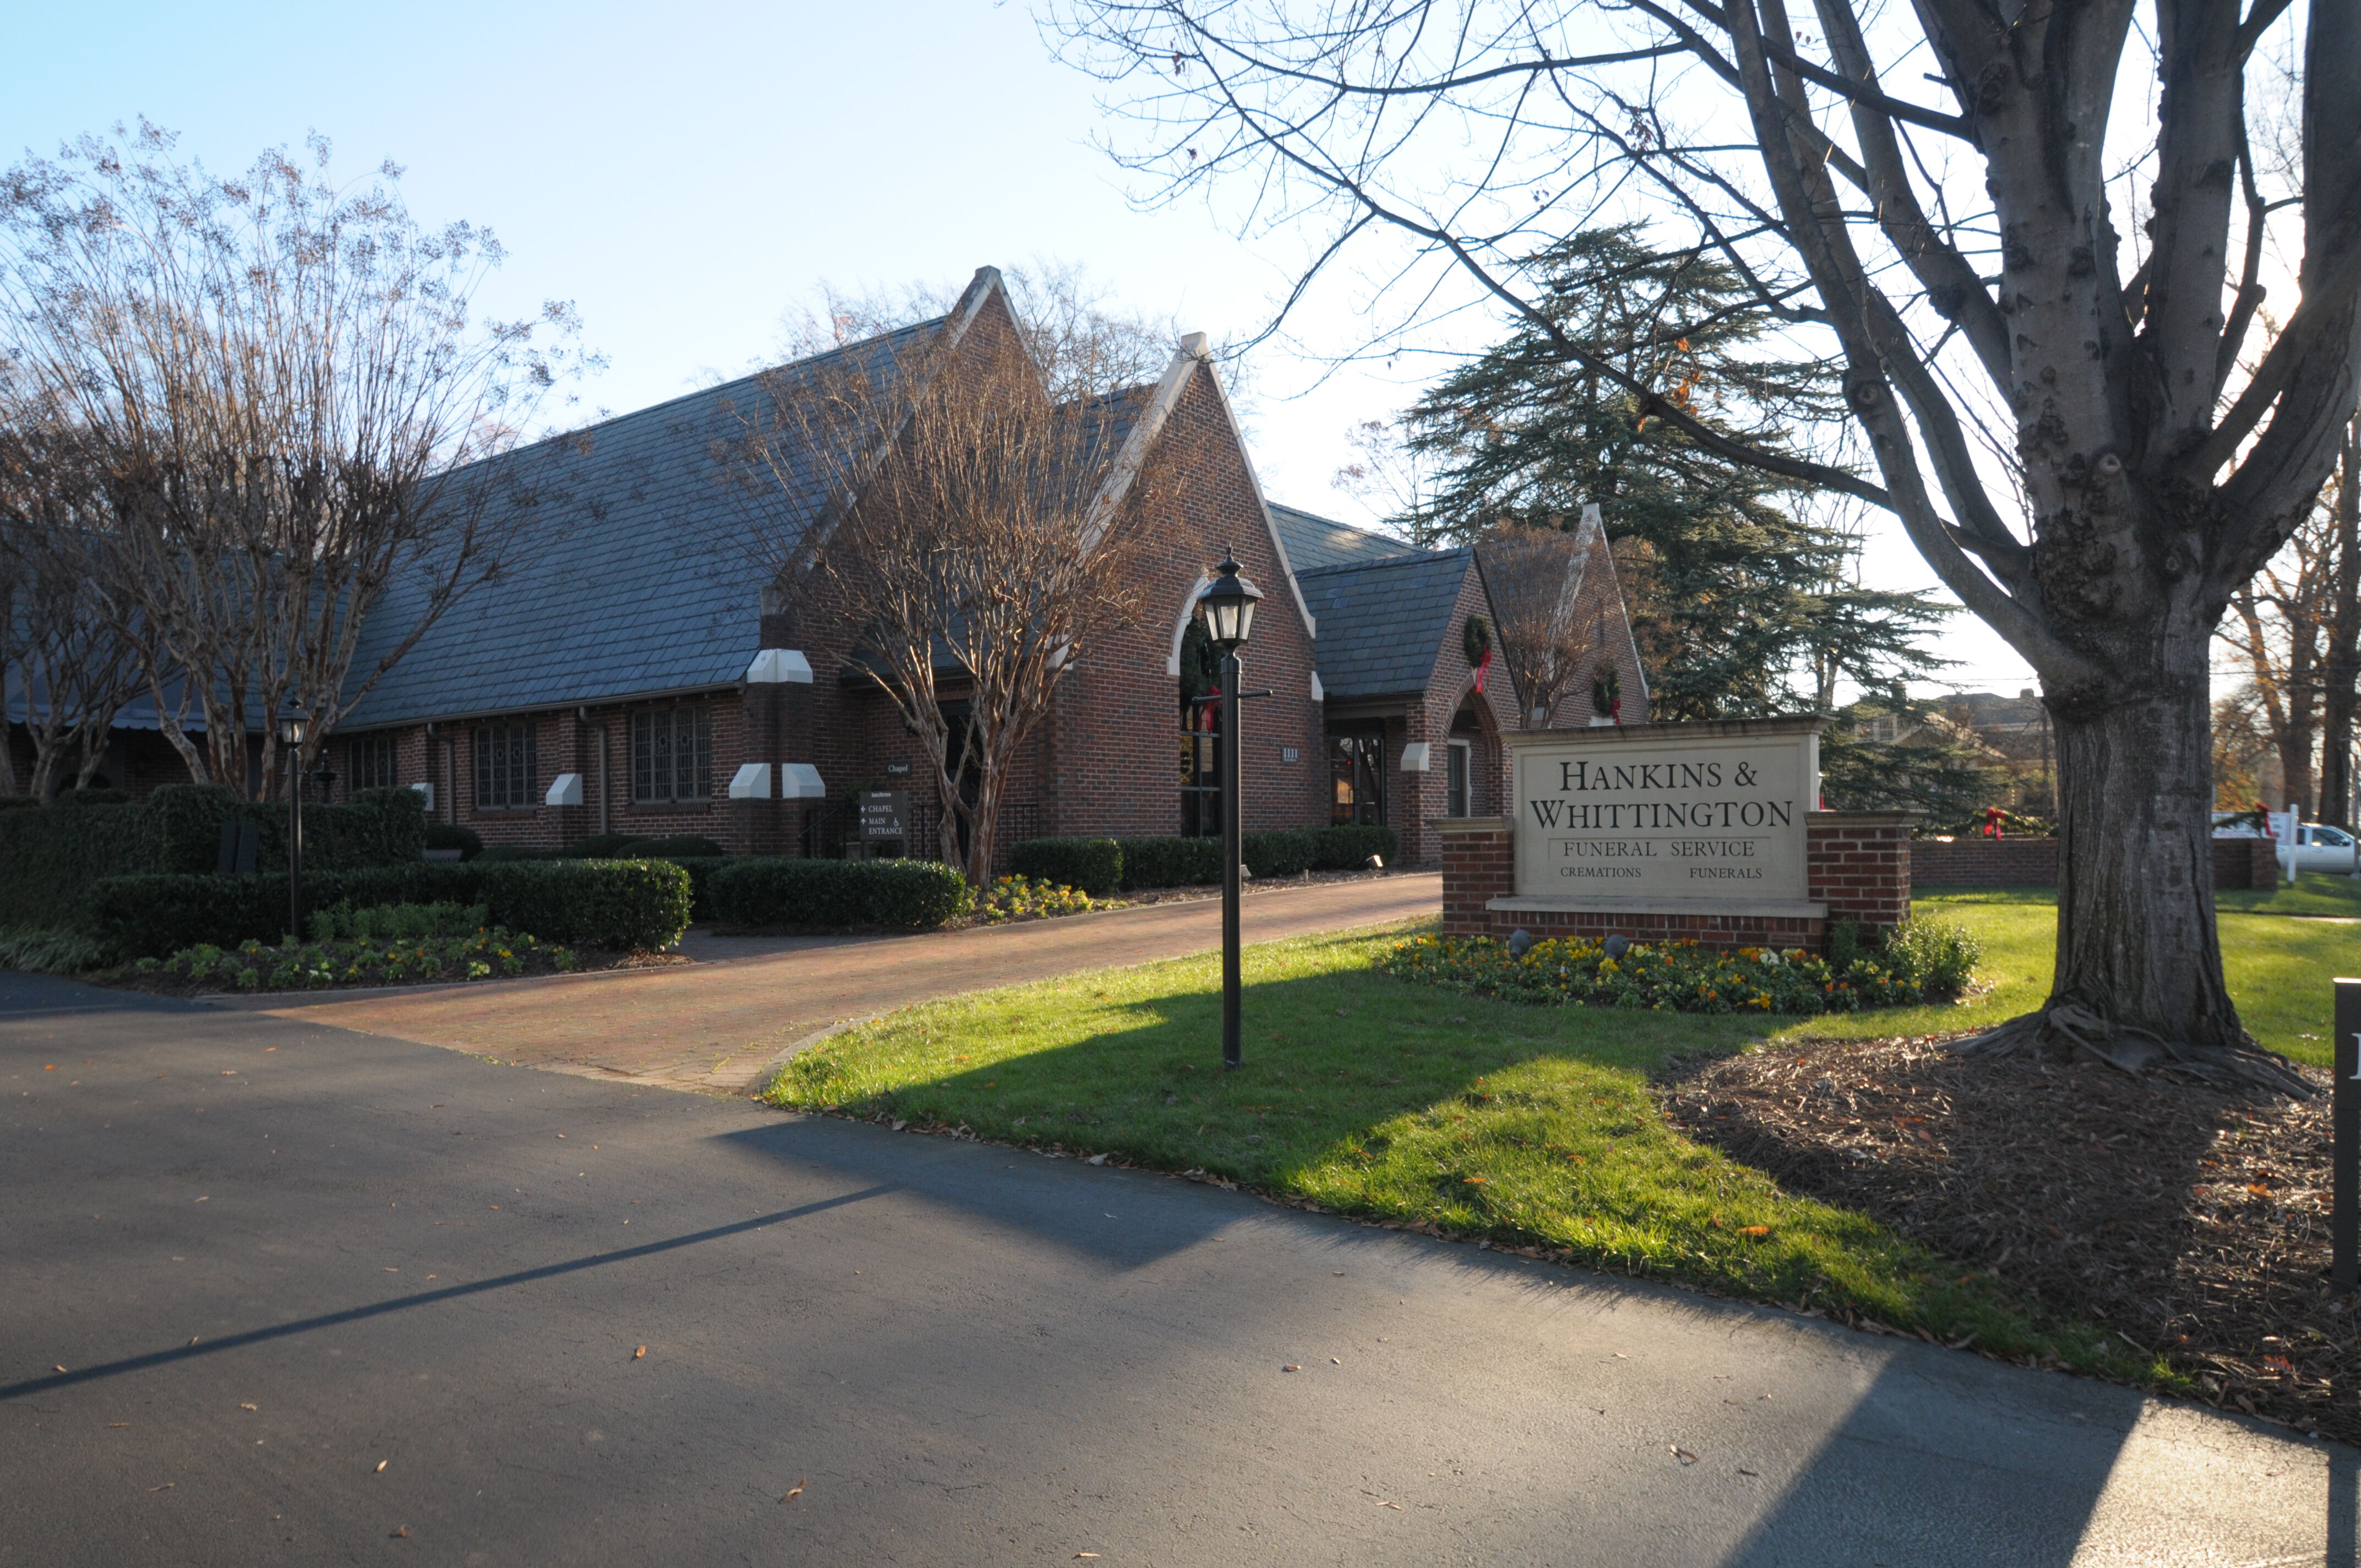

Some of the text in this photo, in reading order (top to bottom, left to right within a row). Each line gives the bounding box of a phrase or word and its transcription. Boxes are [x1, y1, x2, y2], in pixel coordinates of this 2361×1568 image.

[1284, 748, 1298, 758] 1111
[888, 764, 908, 774] Chapel
[1559, 761, 1758, 791] HANKINS &
[1530, 800, 1793, 829] WHITTINGTON
[1564, 841, 1755, 857] FUNERAL SERVICE
[1560, 867, 1762, 879] CREMATIONS FUNERALS
